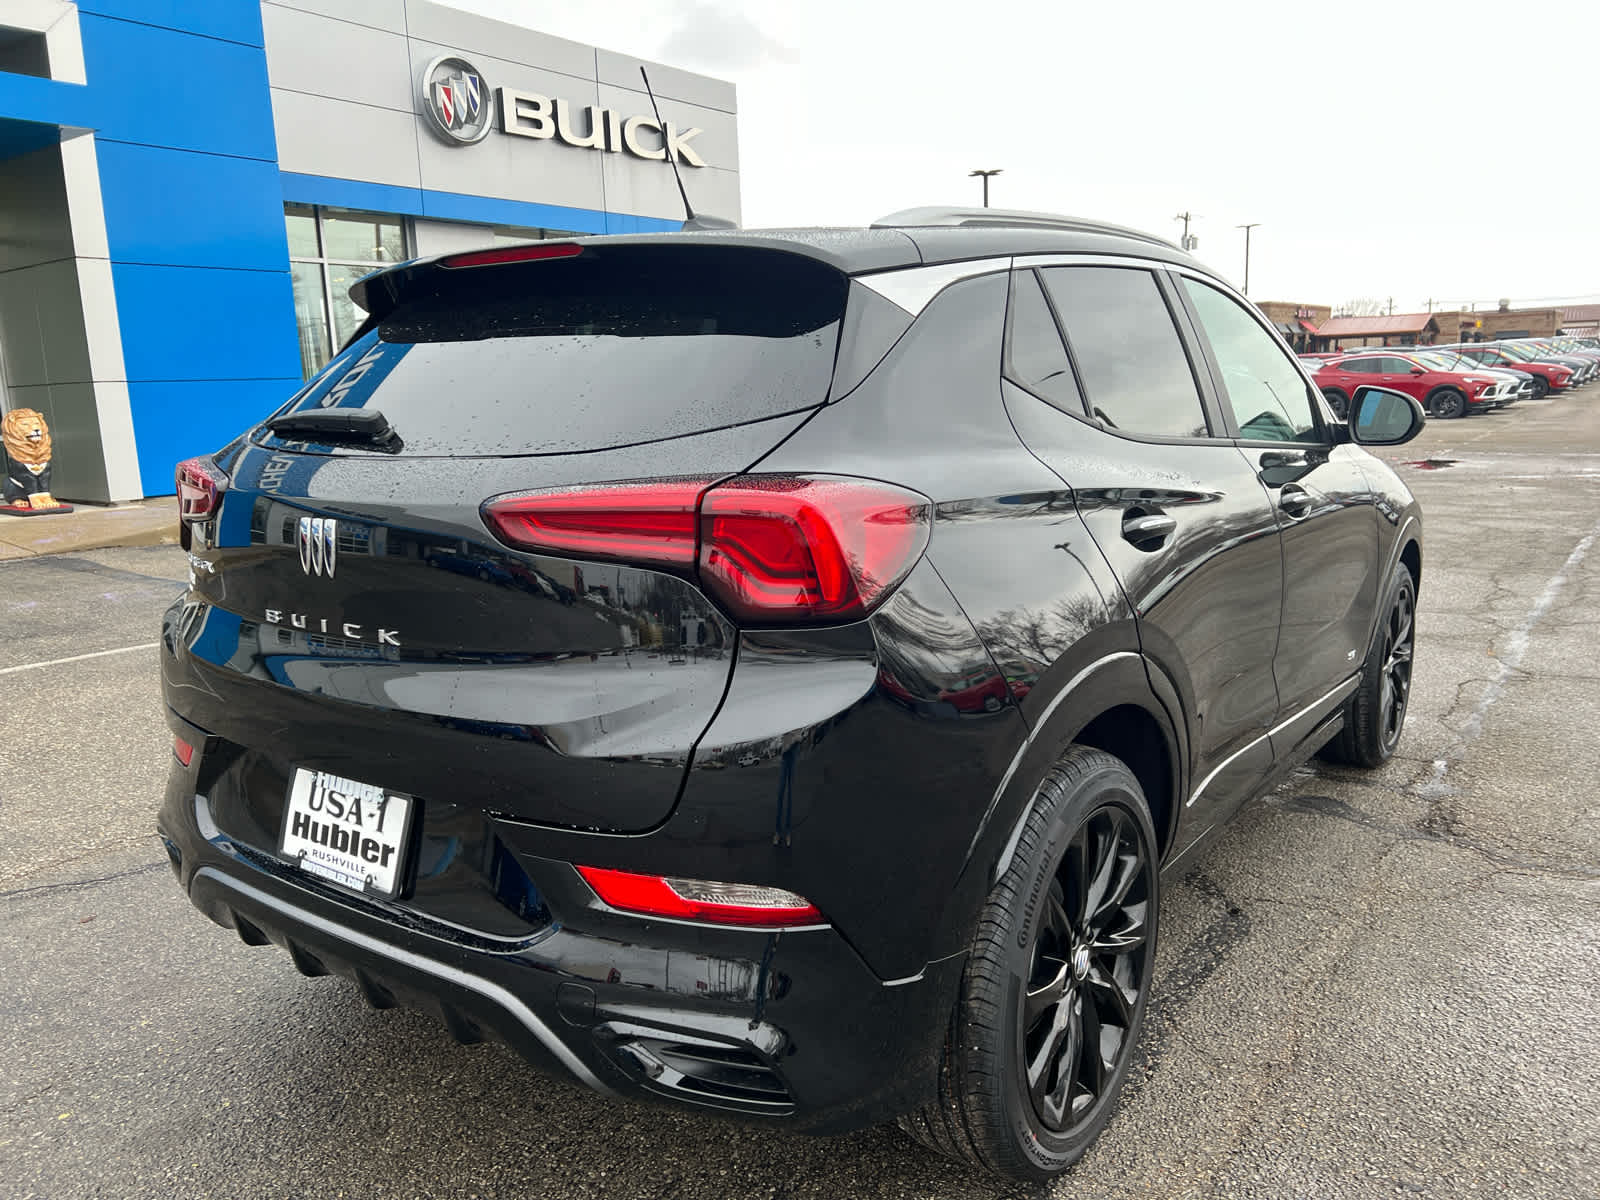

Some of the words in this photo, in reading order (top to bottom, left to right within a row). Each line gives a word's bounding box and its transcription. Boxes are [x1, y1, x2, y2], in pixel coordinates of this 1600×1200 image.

[497, 86, 705, 168] BUICK
[265, 608, 401, 646] BUICK
[308, 779, 390, 833] USA-1
[291, 810, 395, 868] Hubler
[312, 849, 366, 874] RUSHVILLE
[1017, 849, 1056, 949] Continental
